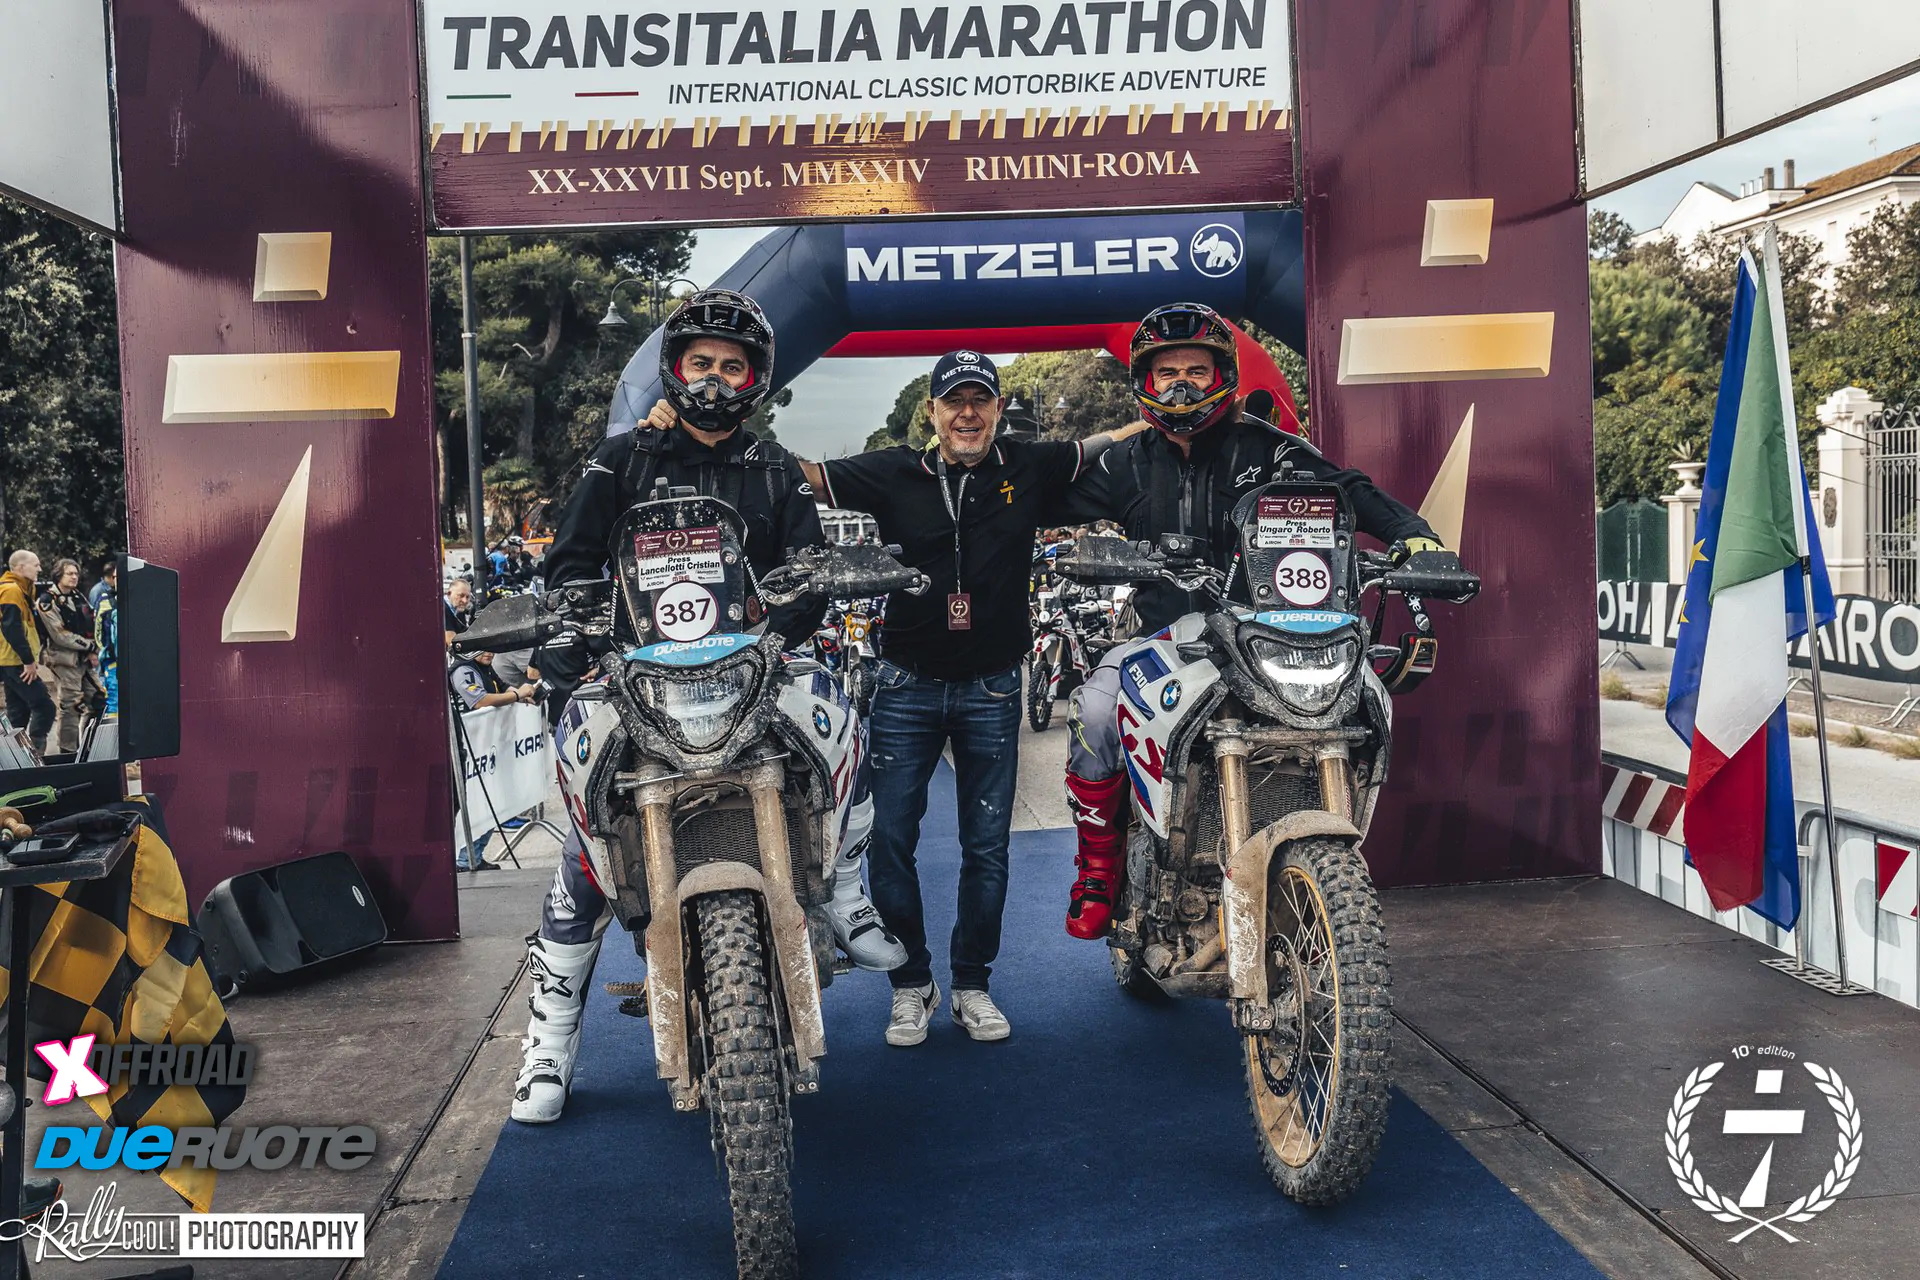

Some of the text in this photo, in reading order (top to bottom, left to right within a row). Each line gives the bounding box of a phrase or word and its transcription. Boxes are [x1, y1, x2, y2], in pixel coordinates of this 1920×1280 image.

[443, 0, 1268, 71] TRANSITALIA MARATHON
[668, 67, 1268, 104] INTERNATIONAL CLASSIC MOTORBIKE ADVENTURE
[528, 150, 1201, 196] XX-XXVII Sept. MMXXIV RIMINI-ROMA
[846, 236, 1180, 282] METZELER
[941, 365, 995, 382] METZELER
[1260, 526, 1331, 535] Ungaro Roberto
[640, 563, 685, 576] Lancellotti
[687, 560, 720, 570] Cristian
[668, 556, 691, 564] Press
[1279, 567, 1328, 590] 388
[659, 597, 712, 627] 387
